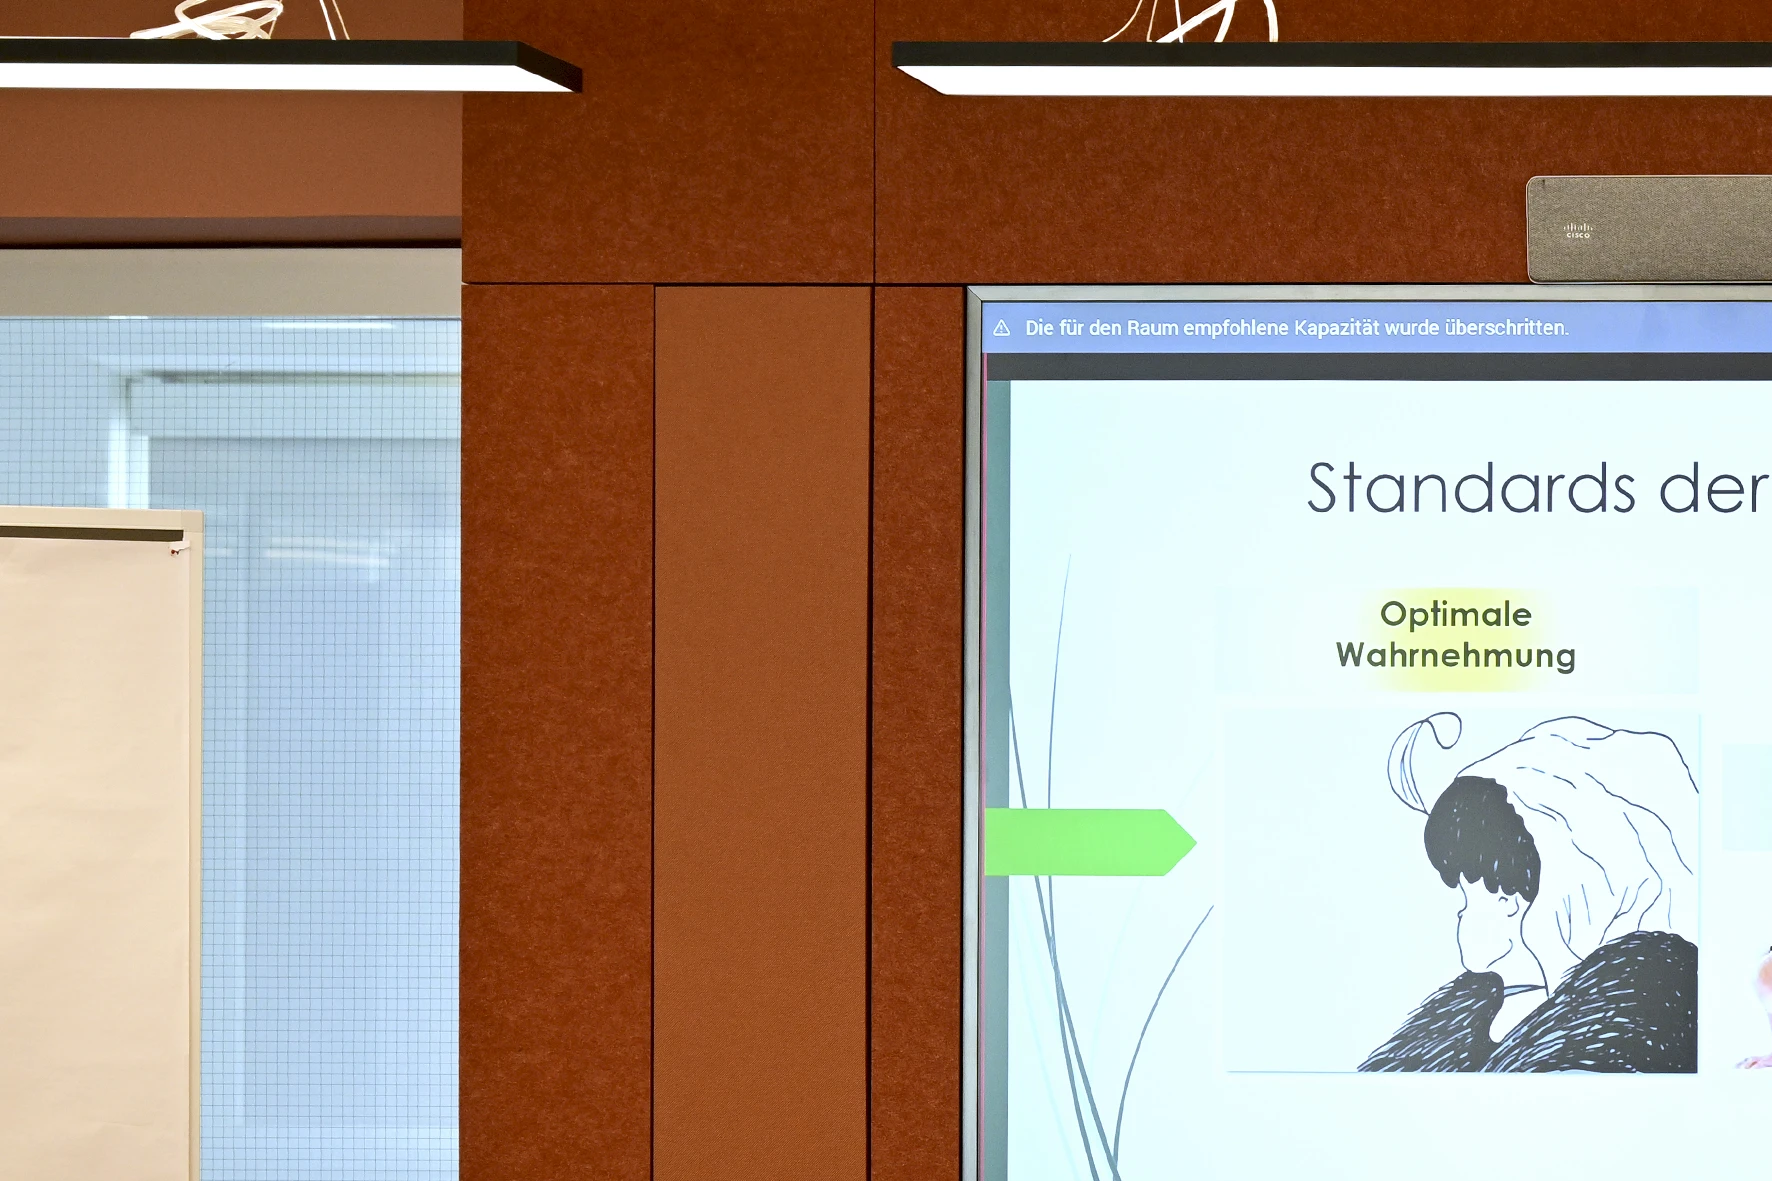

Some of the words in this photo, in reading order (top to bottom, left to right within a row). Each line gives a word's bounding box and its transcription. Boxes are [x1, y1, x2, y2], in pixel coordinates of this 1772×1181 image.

[1026, 319, 1053, 336] Die
[1059, 319, 1085, 336] für
[1089, 319, 1122, 336] den
[1127, 320, 1179, 336] Raum
[1183, 319, 1289, 340] empfohlene
[1295, 318, 1380, 340] Kapazität
[1384, 319, 1440, 336] wurde
[1445, 318, 1569, 336] überschritten.
[1307, 461, 1636, 514] Standards
[1660, 461, 1770, 514] der
[1380, 599, 1532, 633] Optimale
[1336, 641, 1576, 675] Wahrnehmung
